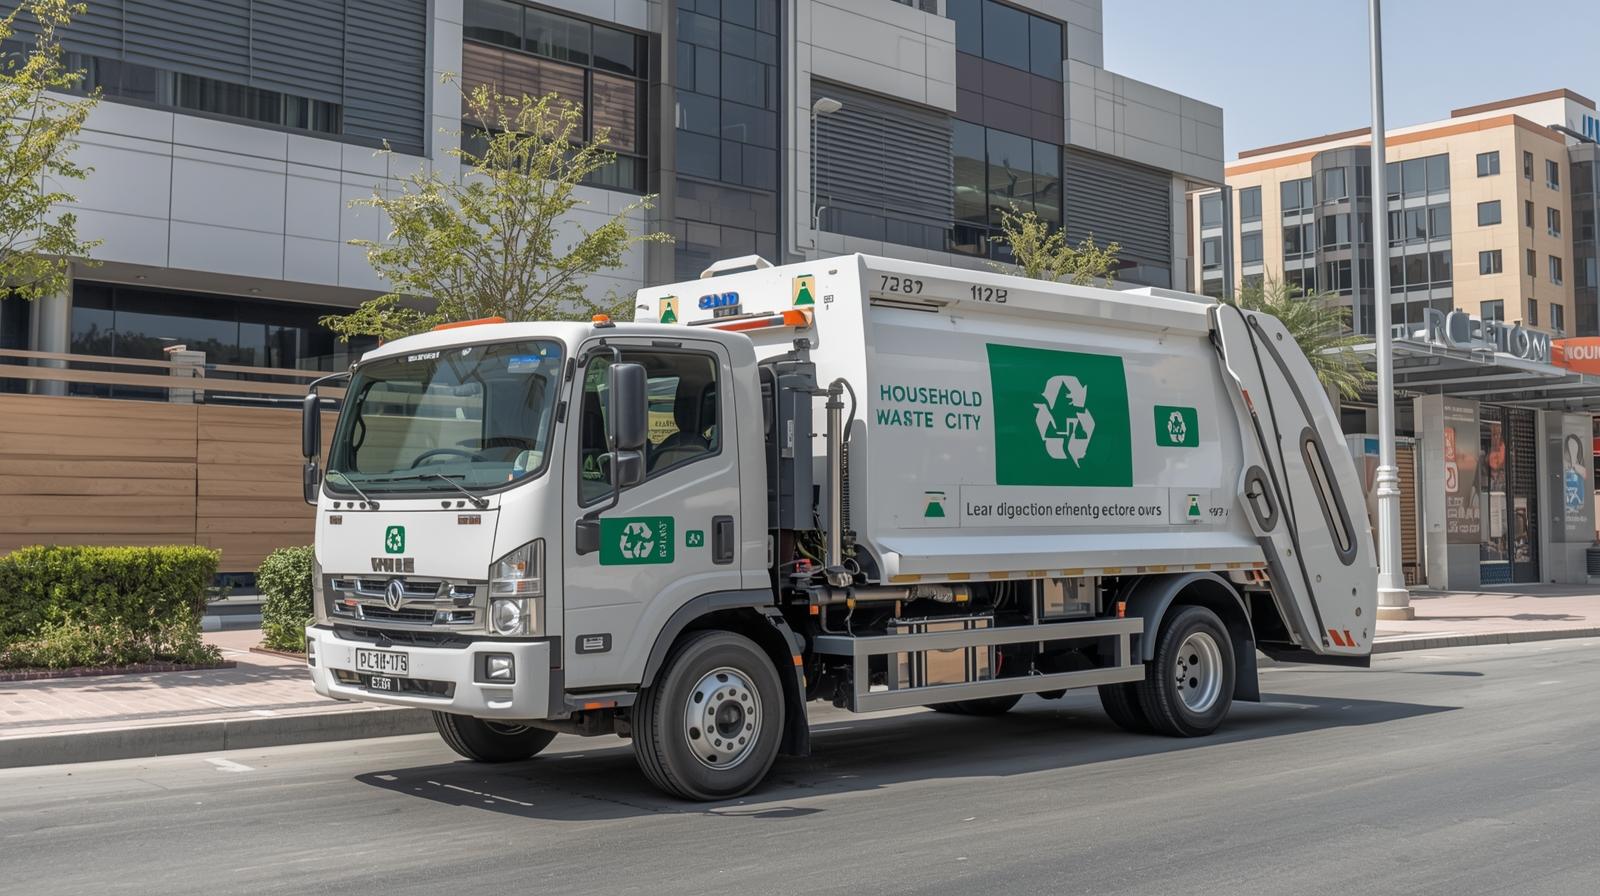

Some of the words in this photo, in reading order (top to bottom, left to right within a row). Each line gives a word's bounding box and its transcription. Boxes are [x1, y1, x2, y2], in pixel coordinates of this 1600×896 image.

[880, 384, 982, 407] HOUSEHOLD
[876, 408, 934, 428] WASTE
[945, 412, 981, 430] CITY
